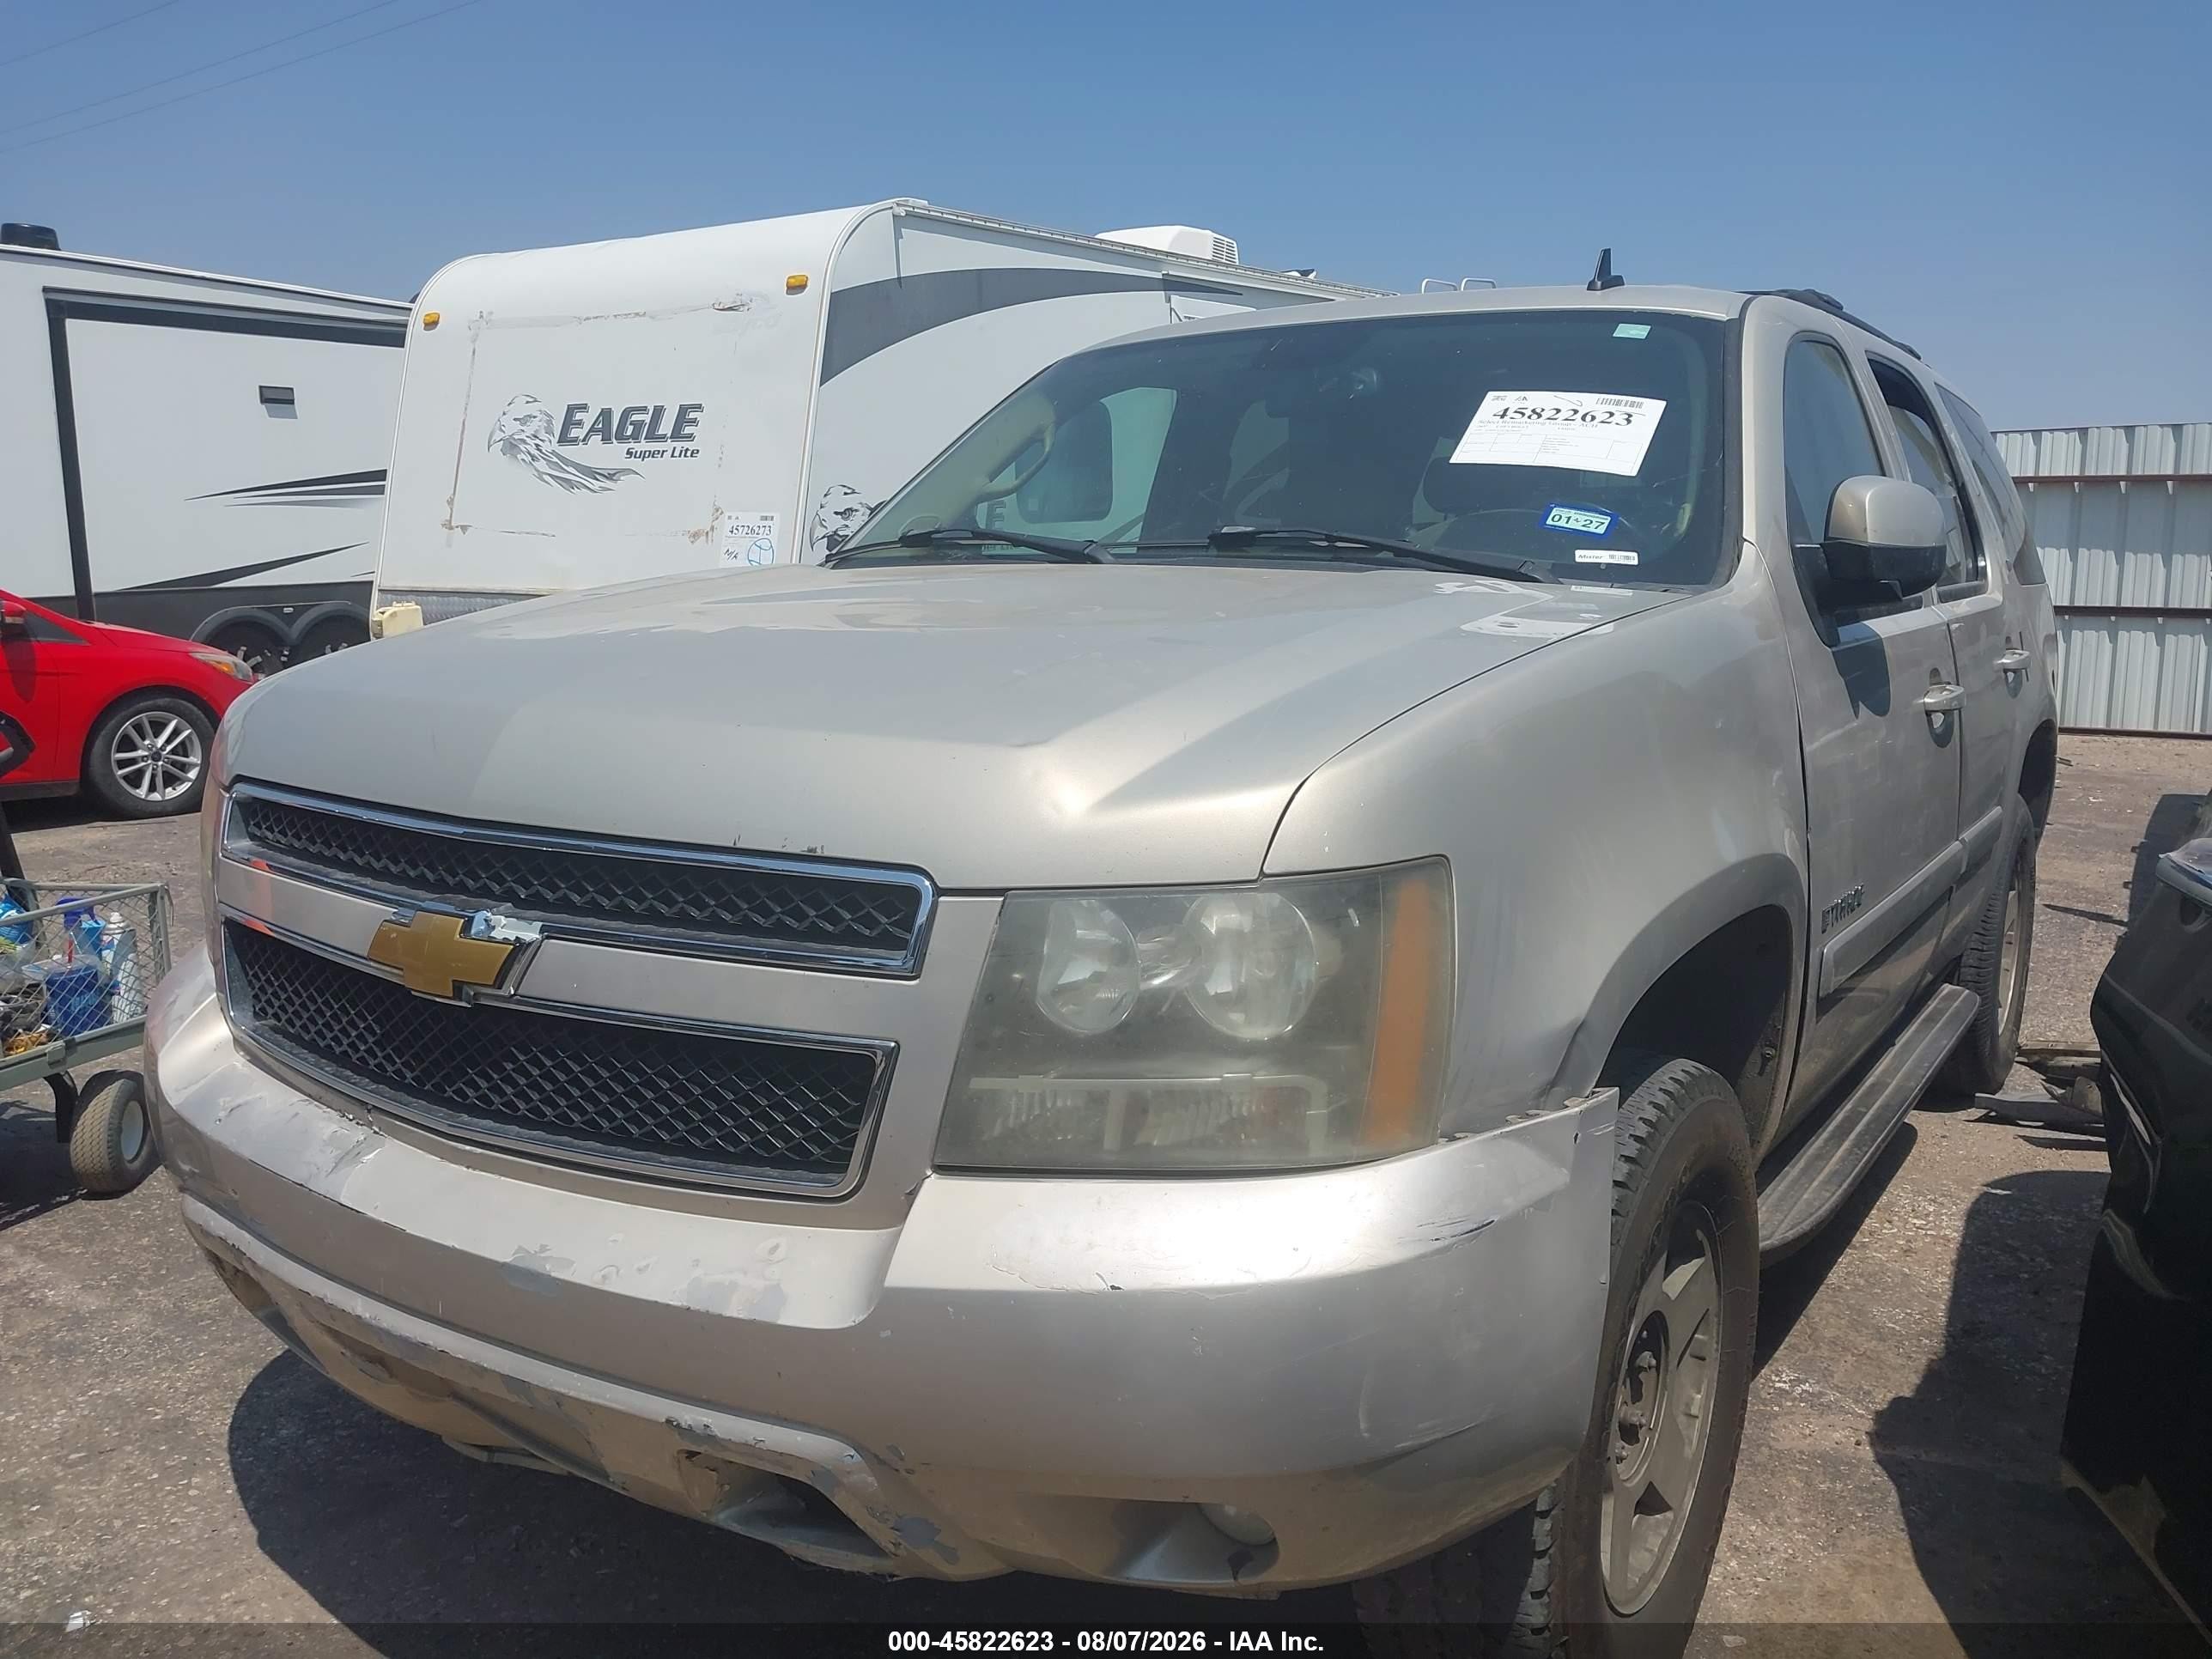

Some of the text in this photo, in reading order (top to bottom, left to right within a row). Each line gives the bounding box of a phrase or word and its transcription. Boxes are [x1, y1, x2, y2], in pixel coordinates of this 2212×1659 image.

[557, 403, 703, 446] EAGLE
[1492, 406, 1633, 427] 45822623
[624, 446, 700, 462] Super Lite
[1551, 514, 1572, 525] 01
[1581, 519, 1606, 530] 27
[728, 525, 772, 536] 45726273
